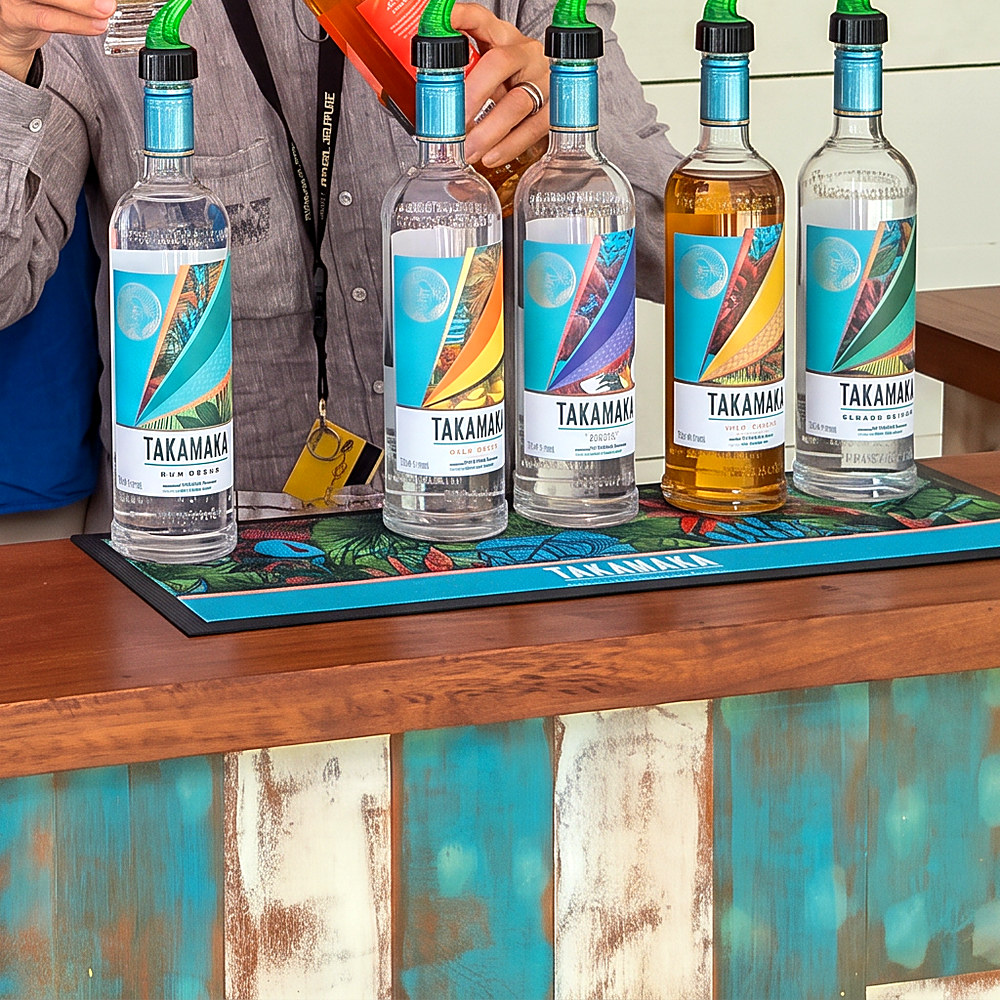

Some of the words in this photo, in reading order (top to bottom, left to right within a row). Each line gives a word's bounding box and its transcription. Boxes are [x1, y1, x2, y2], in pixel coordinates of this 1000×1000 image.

[556, 395, 634, 426] TAKAMAKA
[143, 431, 228, 462] TAKAMAKA
[542, 554, 719, 580] TAKAMAKA
